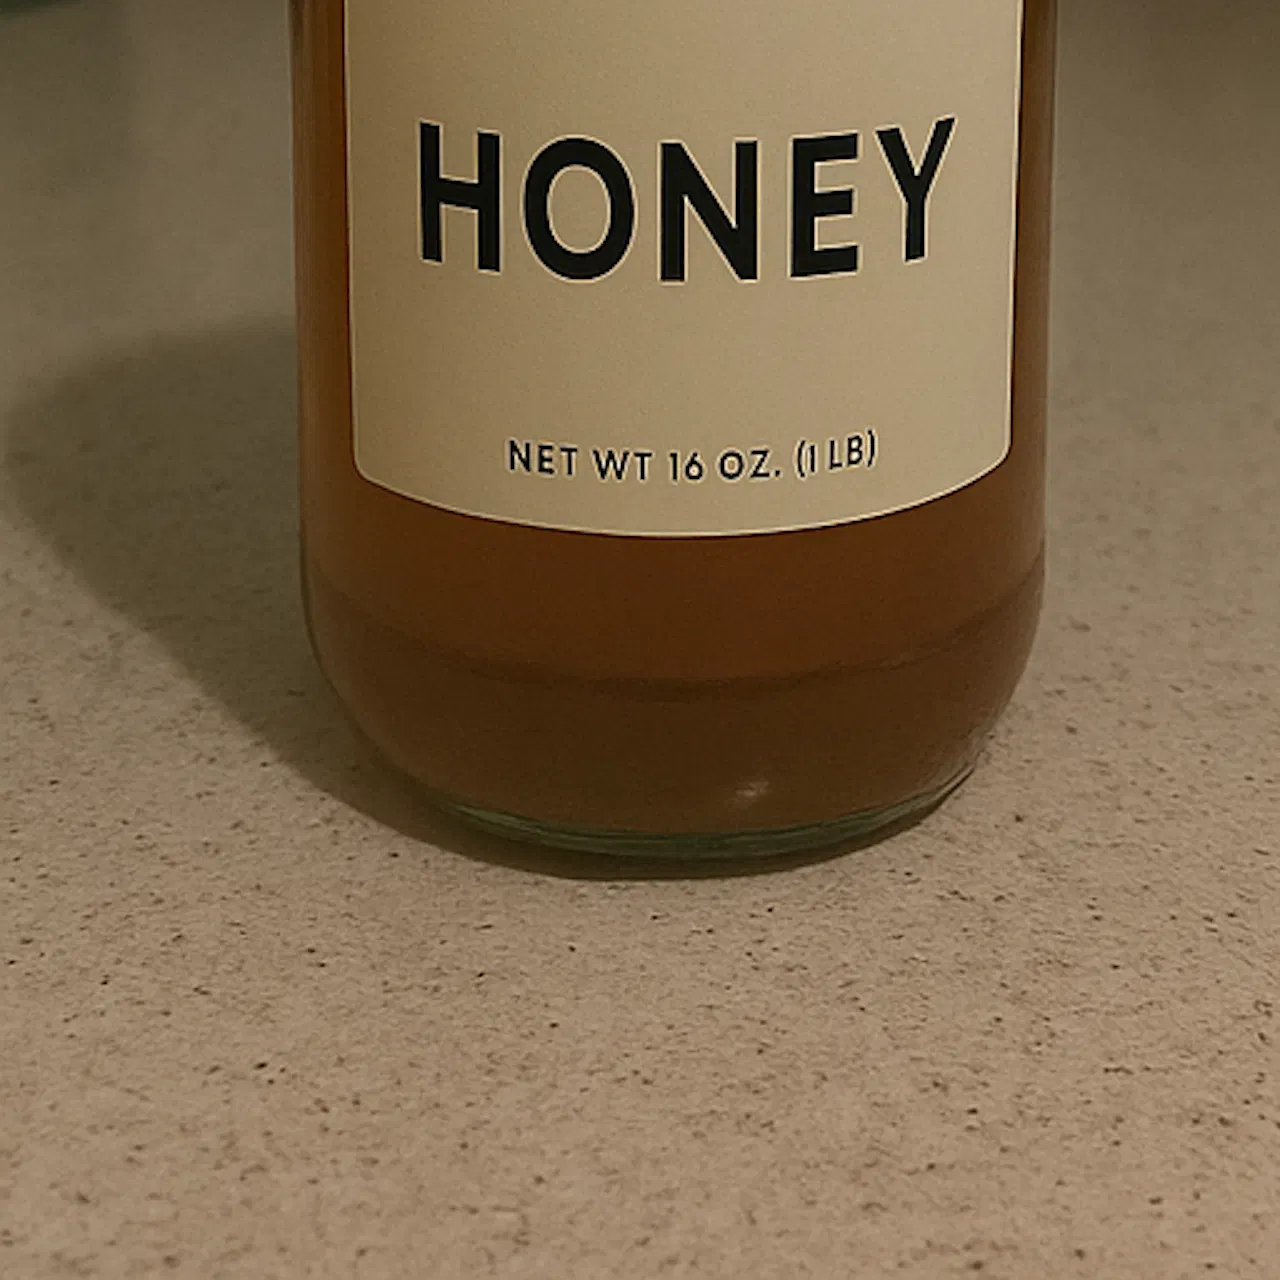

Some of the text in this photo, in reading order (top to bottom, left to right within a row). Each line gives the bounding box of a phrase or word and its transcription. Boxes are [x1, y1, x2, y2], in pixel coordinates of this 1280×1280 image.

[419, 117, 955, 283] HONEY
[508, 439, 580, 477] NET
[592, 448, 653, 481] WT
[669, 451, 704, 482] 16
[718, 449, 782, 480] OZ.
[828, 429, 876, 471] LB)
